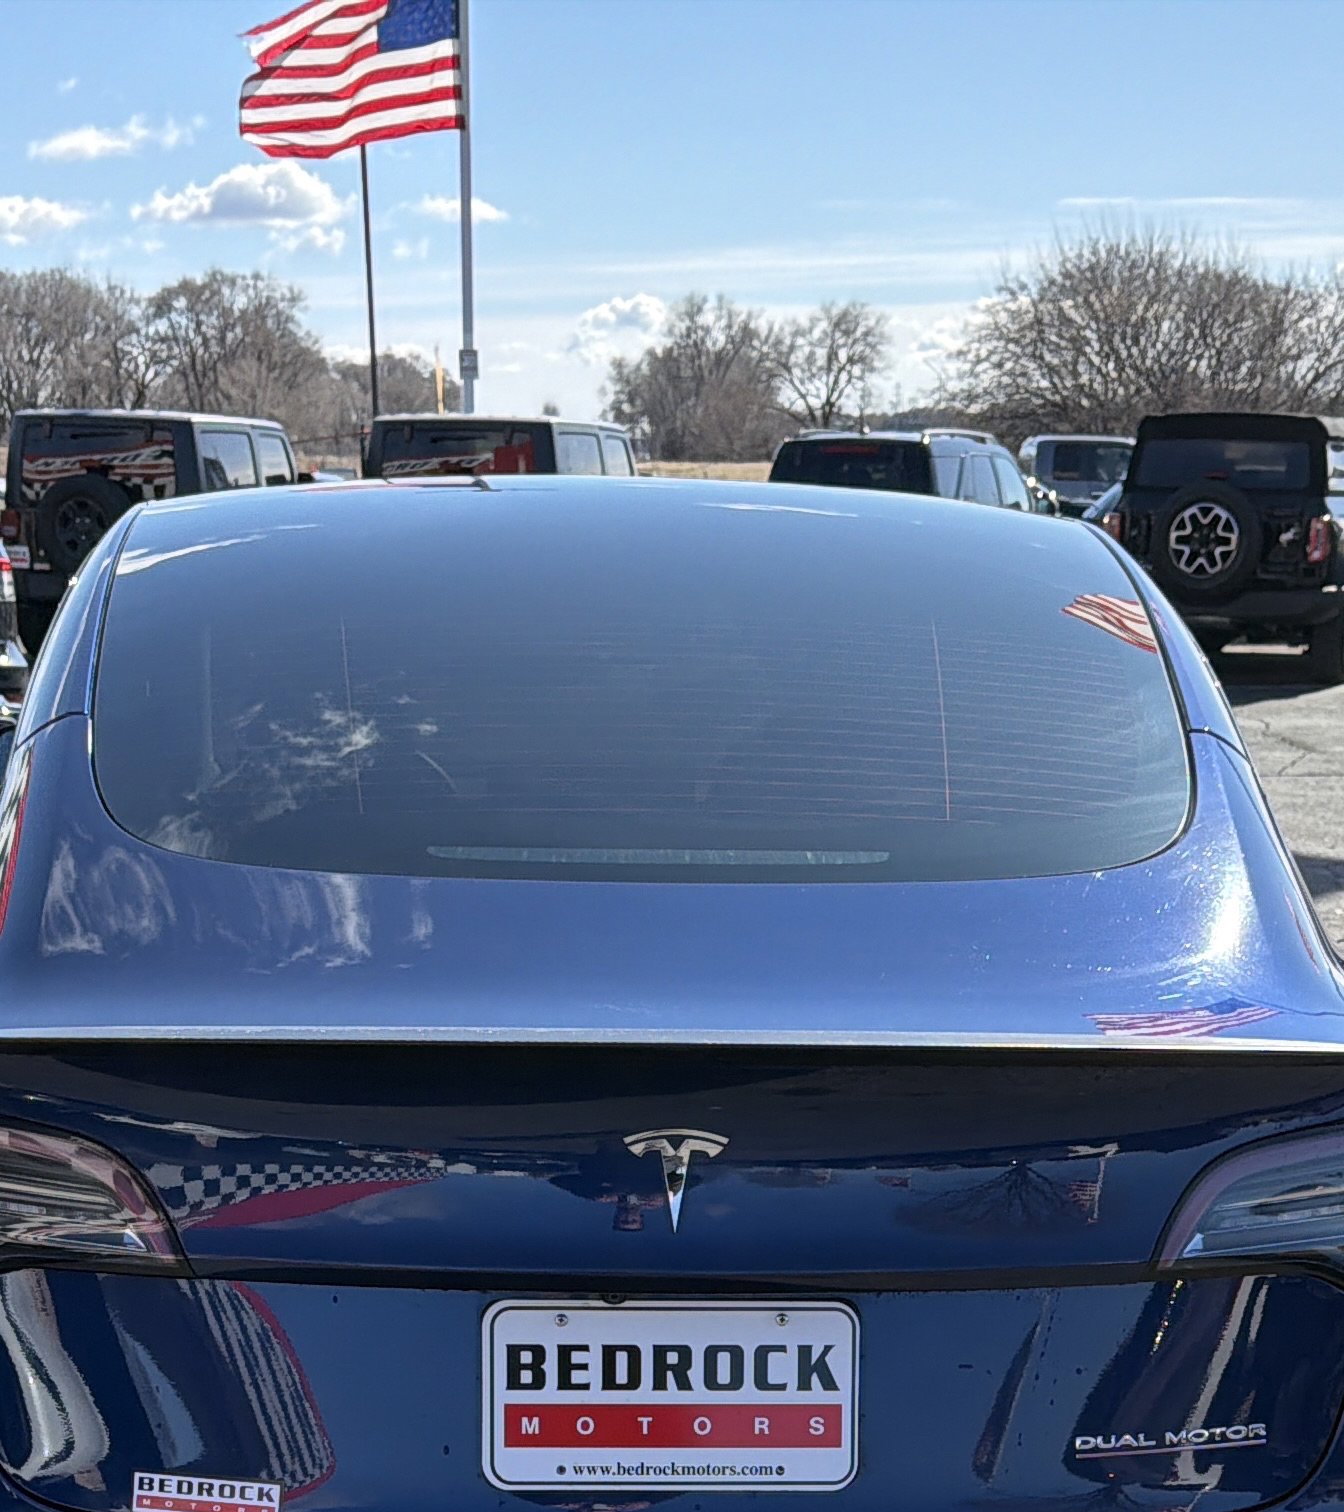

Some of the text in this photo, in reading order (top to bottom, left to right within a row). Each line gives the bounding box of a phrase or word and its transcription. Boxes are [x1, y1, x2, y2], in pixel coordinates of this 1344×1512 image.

[505, 1343, 841, 1392] BEDROCK
[521, 1416, 825, 1436] MOTORS
[1075, 1423, 1267, 1450] DUAL MOTOR
[572, 1461, 774, 1477] www.bedrockmotors.com
[138, 1476, 275, 1503] BEDROCK
